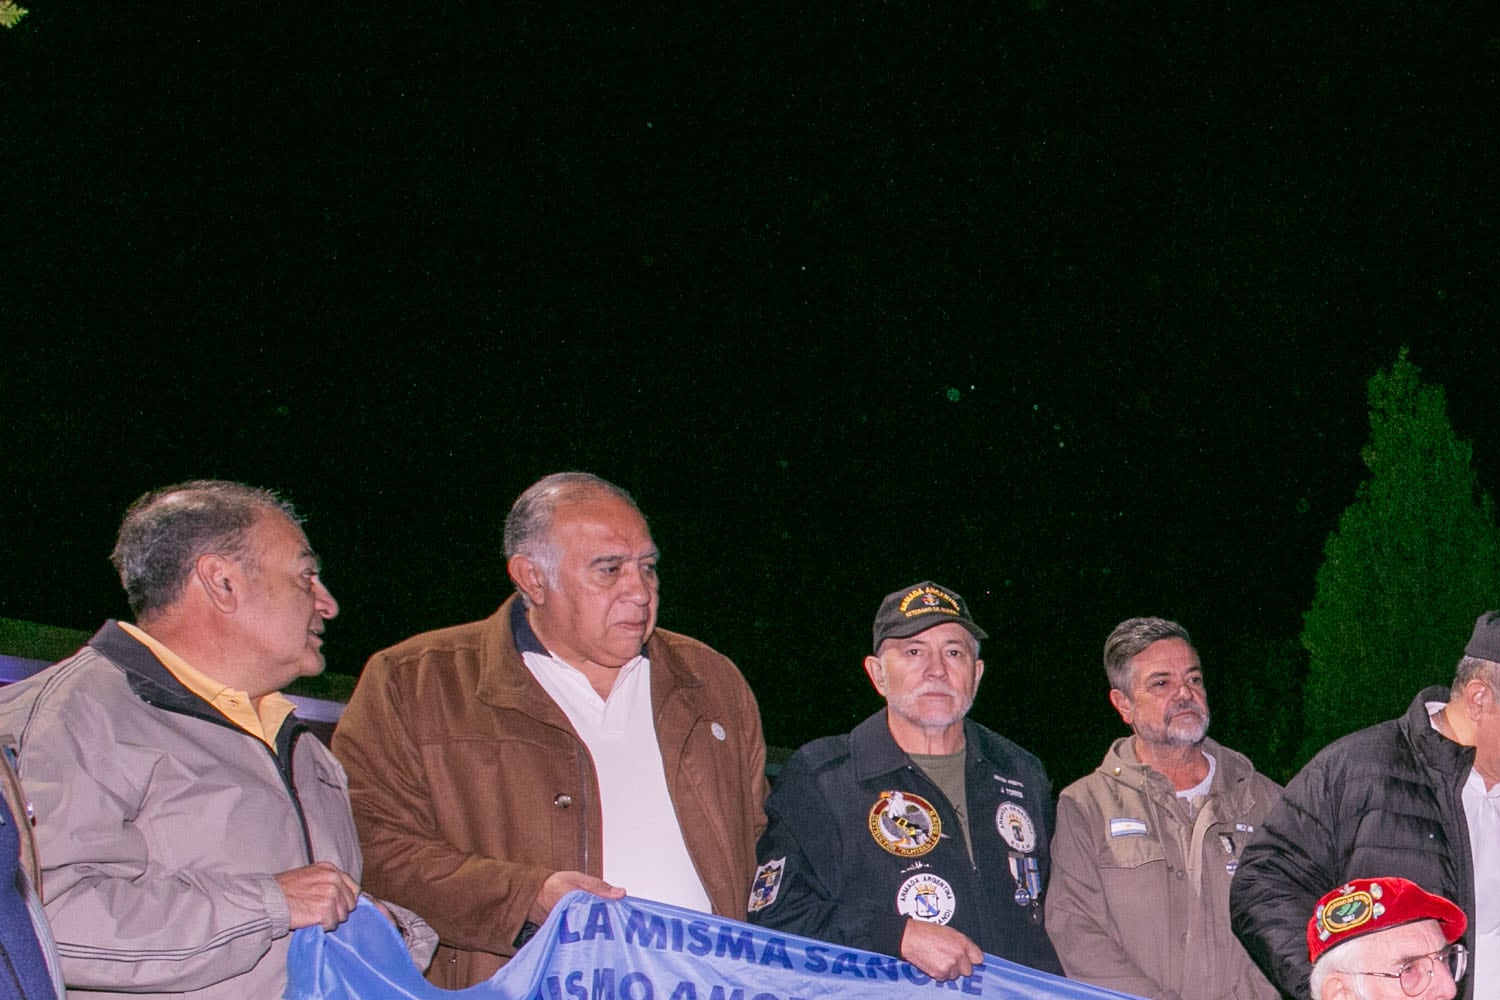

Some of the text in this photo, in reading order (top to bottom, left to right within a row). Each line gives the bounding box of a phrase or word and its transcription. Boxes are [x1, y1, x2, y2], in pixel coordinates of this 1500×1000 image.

[900, 876, 953, 902] ARMADA ARGENTINA
[559, 902, 987, 996] LA MISMA SANE
